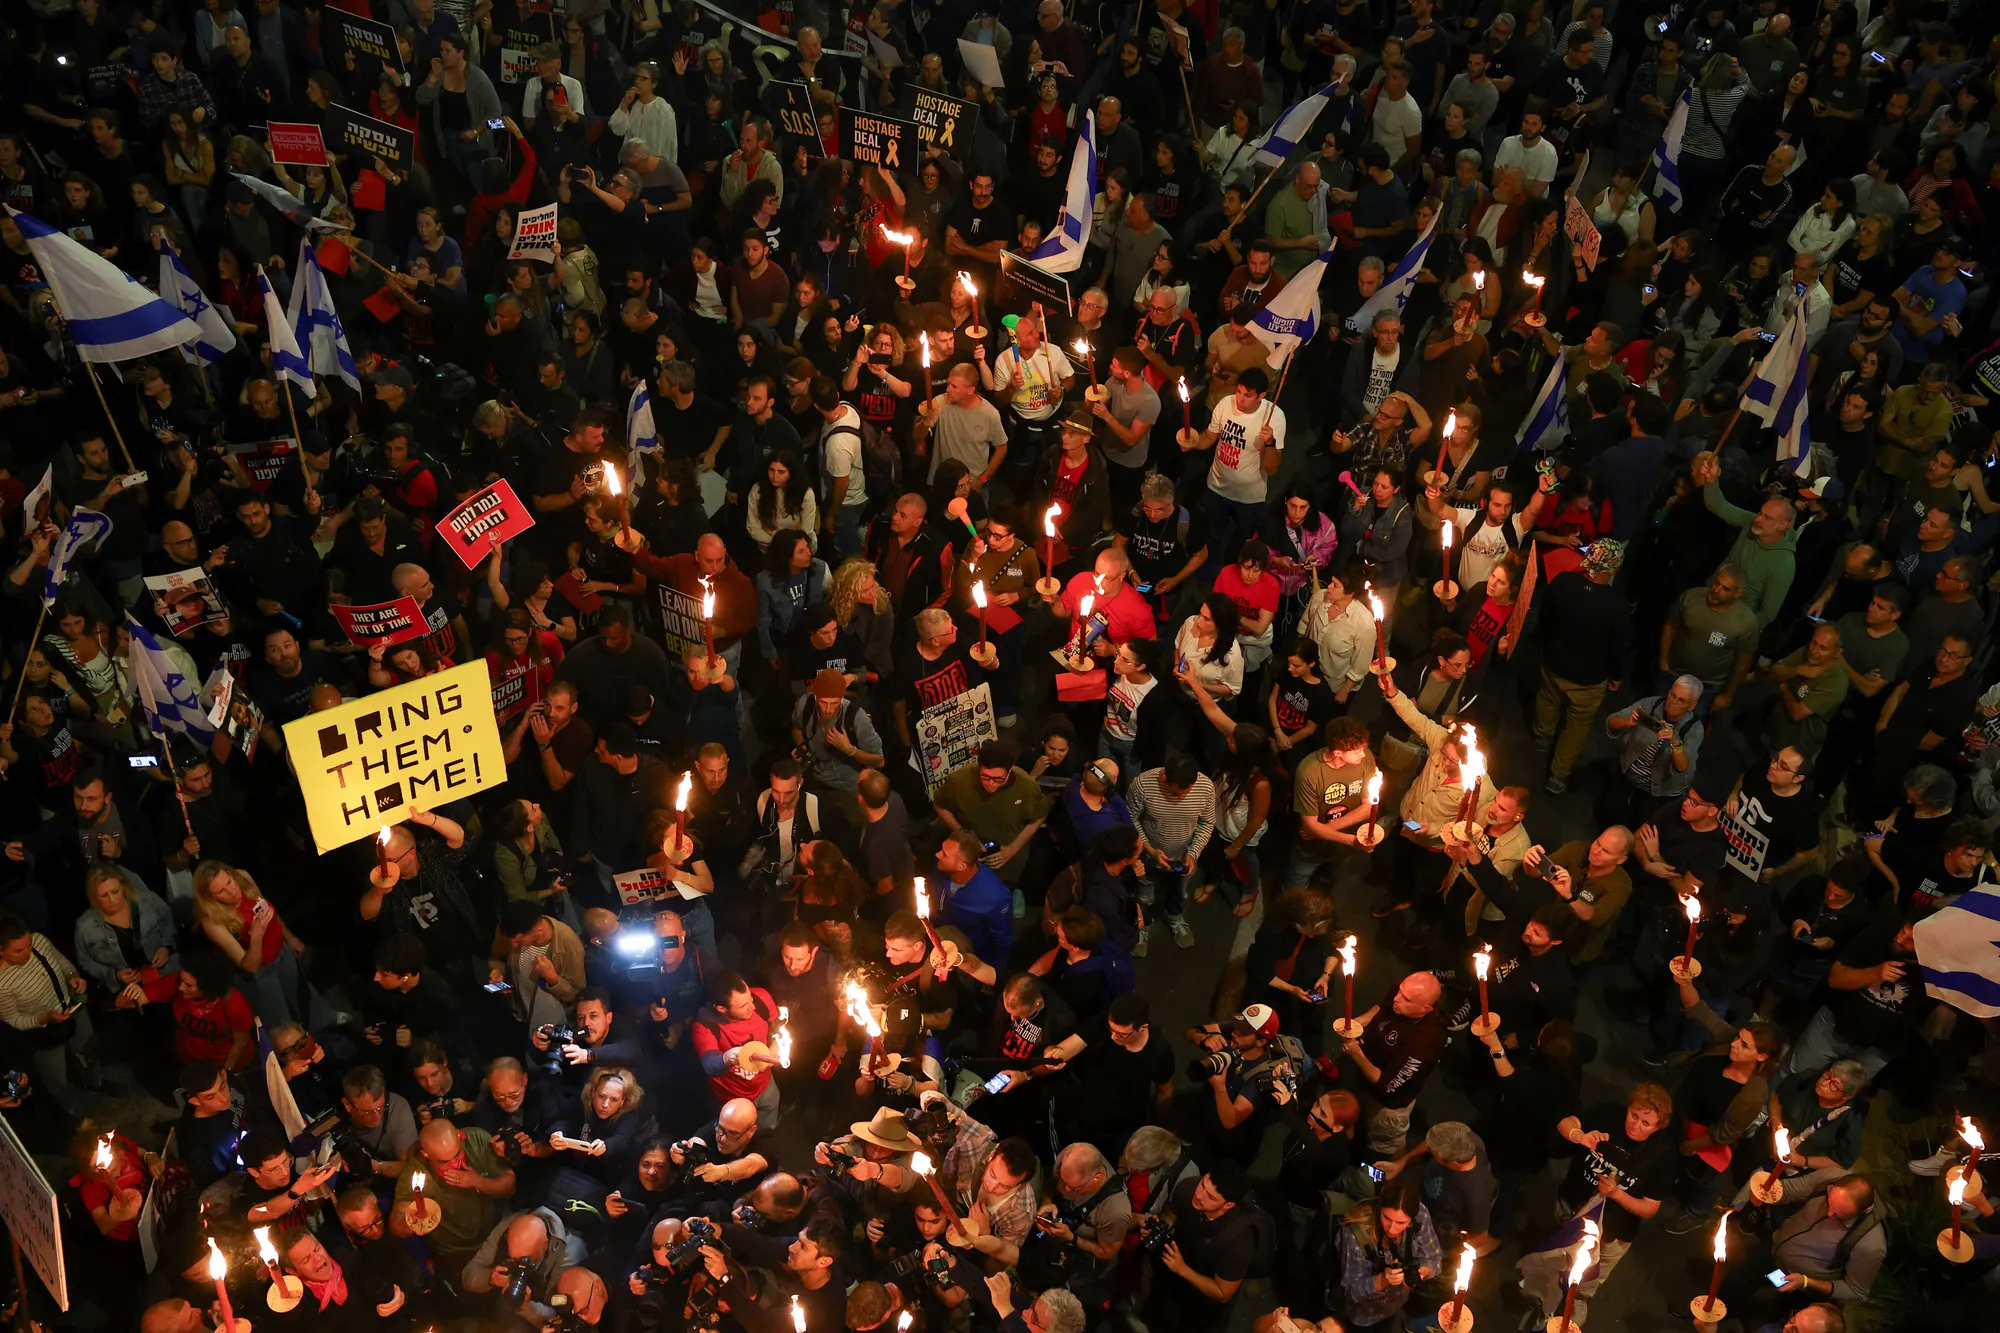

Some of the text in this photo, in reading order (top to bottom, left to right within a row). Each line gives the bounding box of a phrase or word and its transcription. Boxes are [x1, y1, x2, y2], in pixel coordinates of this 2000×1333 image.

[343, 22, 384, 47] עסקה
[343, 35, 391, 60] עכשיו!
[915, 93, 963, 118] HOSTAGE
[854, 115, 902, 139] HOSTAGE
[913, 107, 939, 127] DEAL
[347, 121, 397, 148] עסקה
[854, 131, 881, 149] DEAL
[918, 125, 938, 143] OW
[344, 130, 401, 161] עכשיו!
[854, 147, 881, 164] NOW
[520, 219, 555, 235] אותו
[521, 211, 555, 224] מחליפים
[518, 232, 555, 243] מצילים
[1268, 322, 1292, 333] בארצנו
[1271, 314, 1295, 327] חופשי
[1029, 399, 1049, 408] NOW
[1224, 419, 1246, 438] אתה
[1220, 431, 1246, 450] הראש
[1220, 441, 1241, 459] אתה
[474, 492, 503, 514] נגמר
[464, 509, 505, 542] הזמן!
[351, 608, 400, 624] THEY ARE
[351, 615, 414, 635] OUT OF TIME
[661, 607, 681, 633] NO
[923, 667, 966, 706] STOP
[317, 684, 462, 758] BRING
[326, 729, 452, 790] THEM
[341, 752, 482, 827] HOME!
[1325, 788, 1347, 801] אשם
[1727, 844, 1760, 871] לעס
